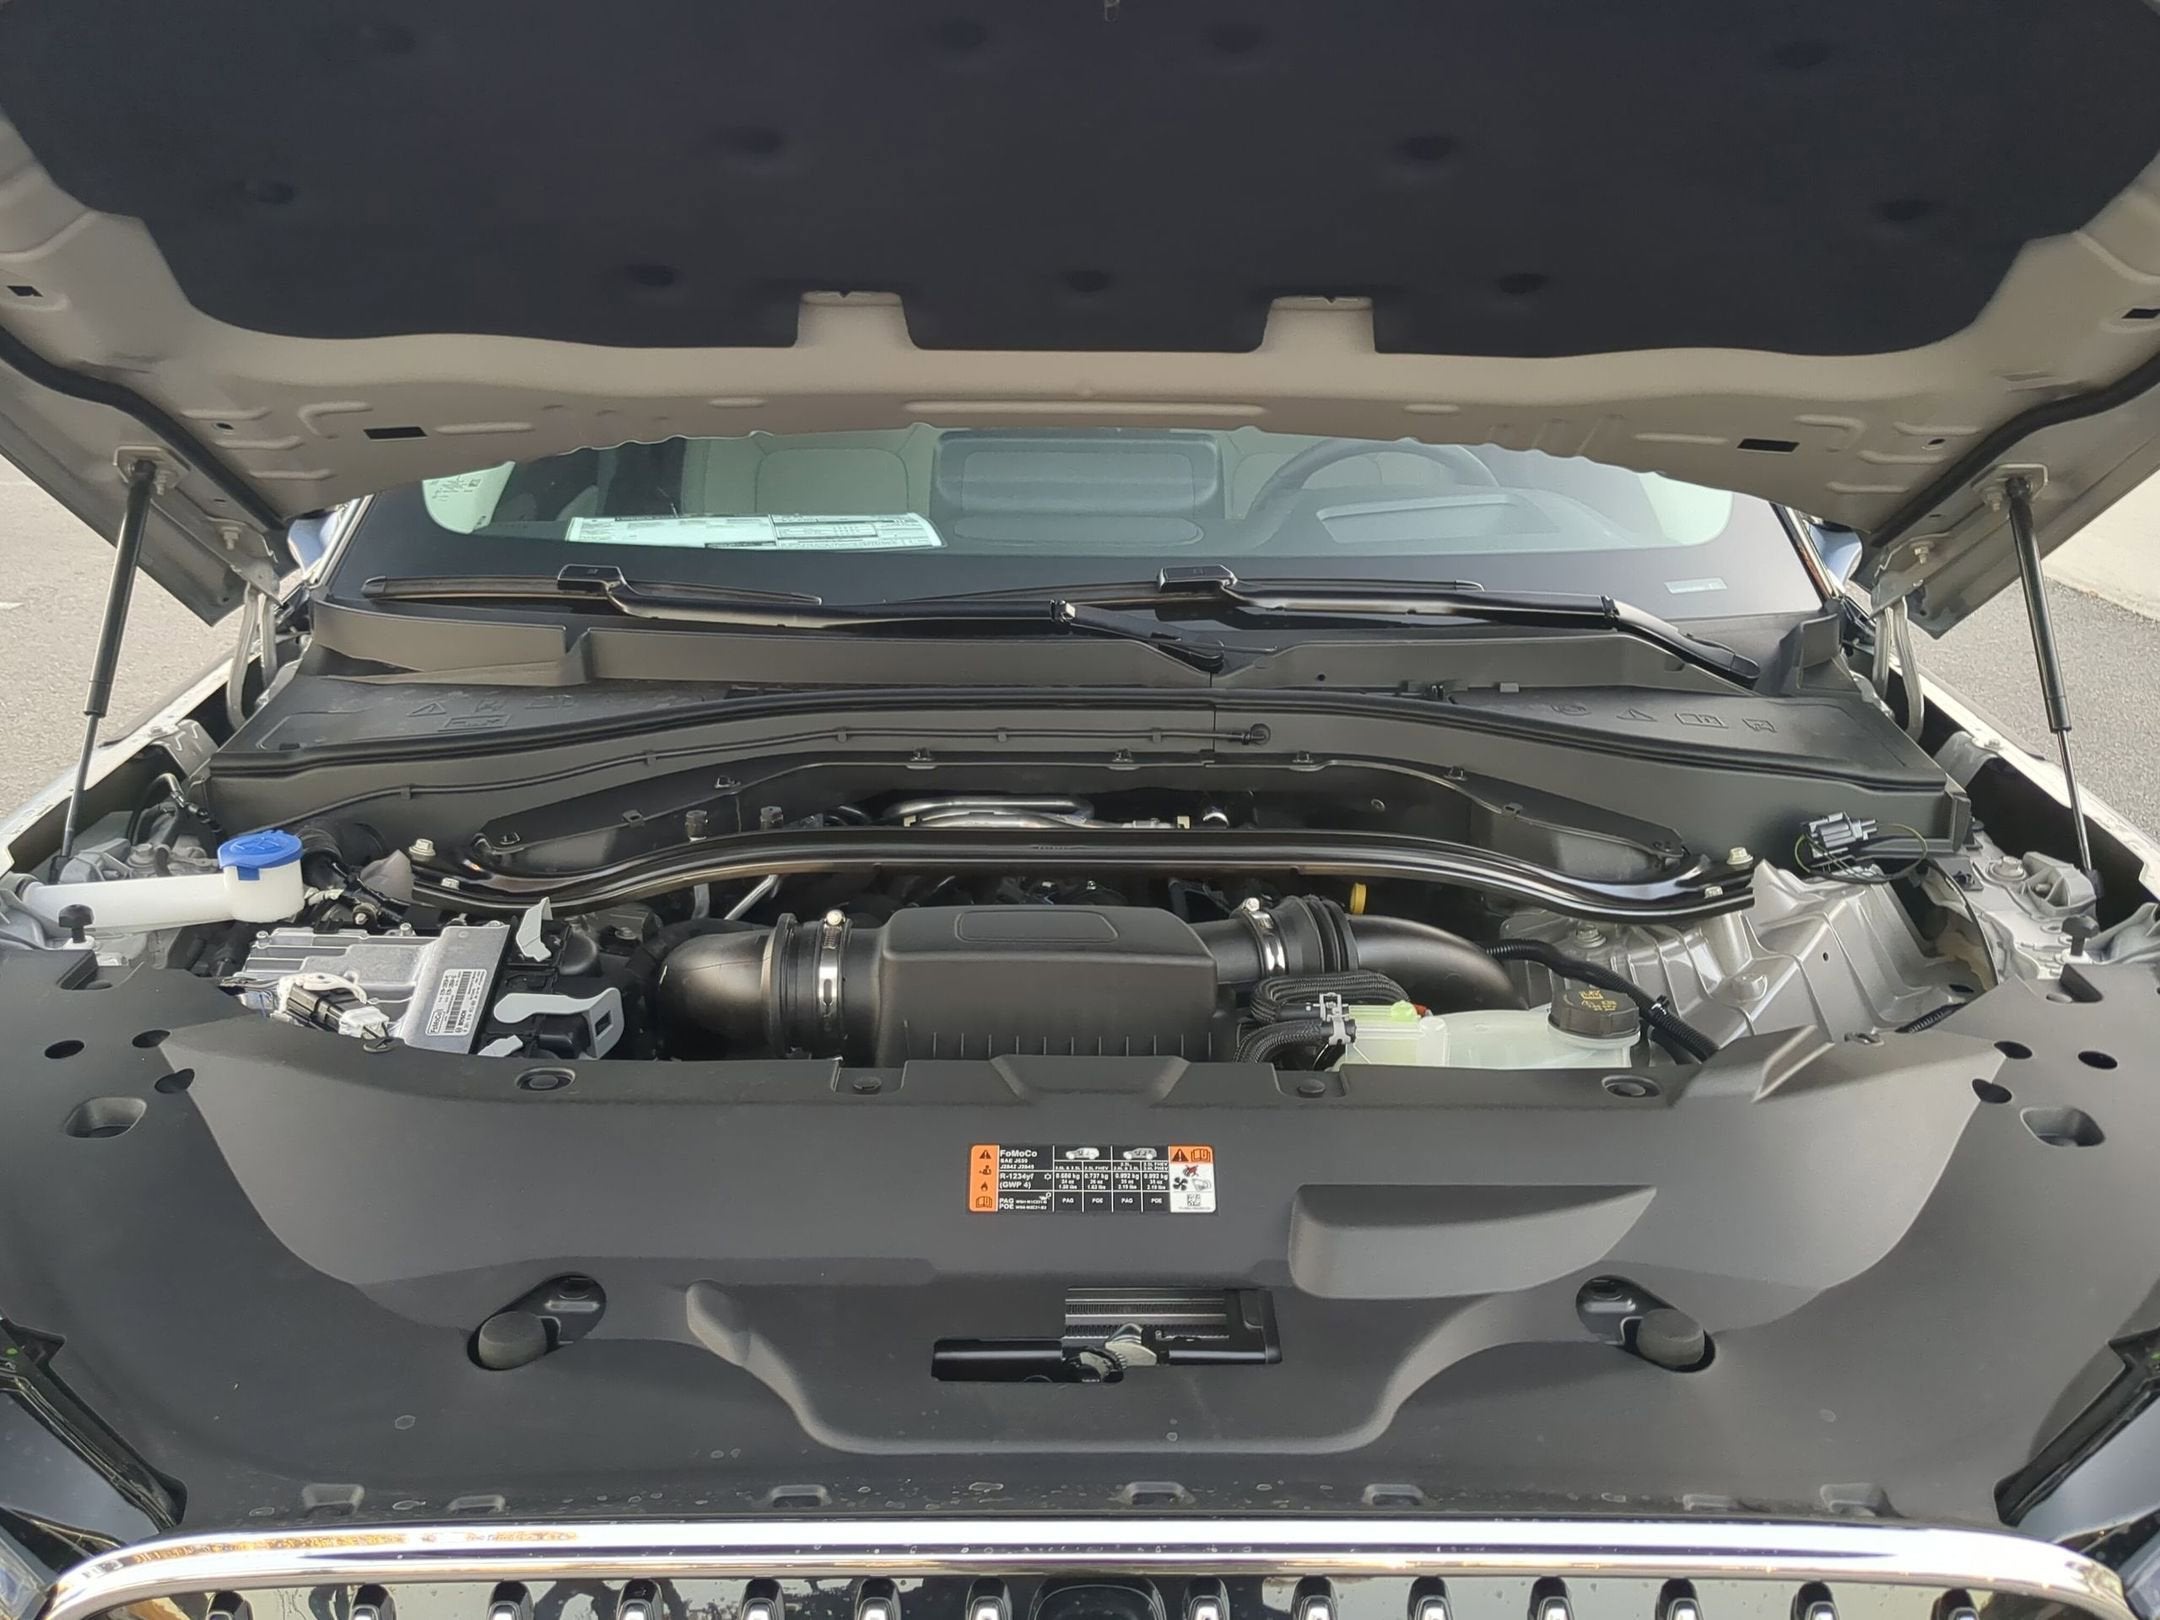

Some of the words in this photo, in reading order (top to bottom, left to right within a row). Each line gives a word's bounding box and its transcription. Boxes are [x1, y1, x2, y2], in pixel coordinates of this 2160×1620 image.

[1000, 1150, 1038, 1158] FoMoCo
[1000, 1181, 1021, 1189] (GWP
[1024, 1181, 1032, 1190] 4)
